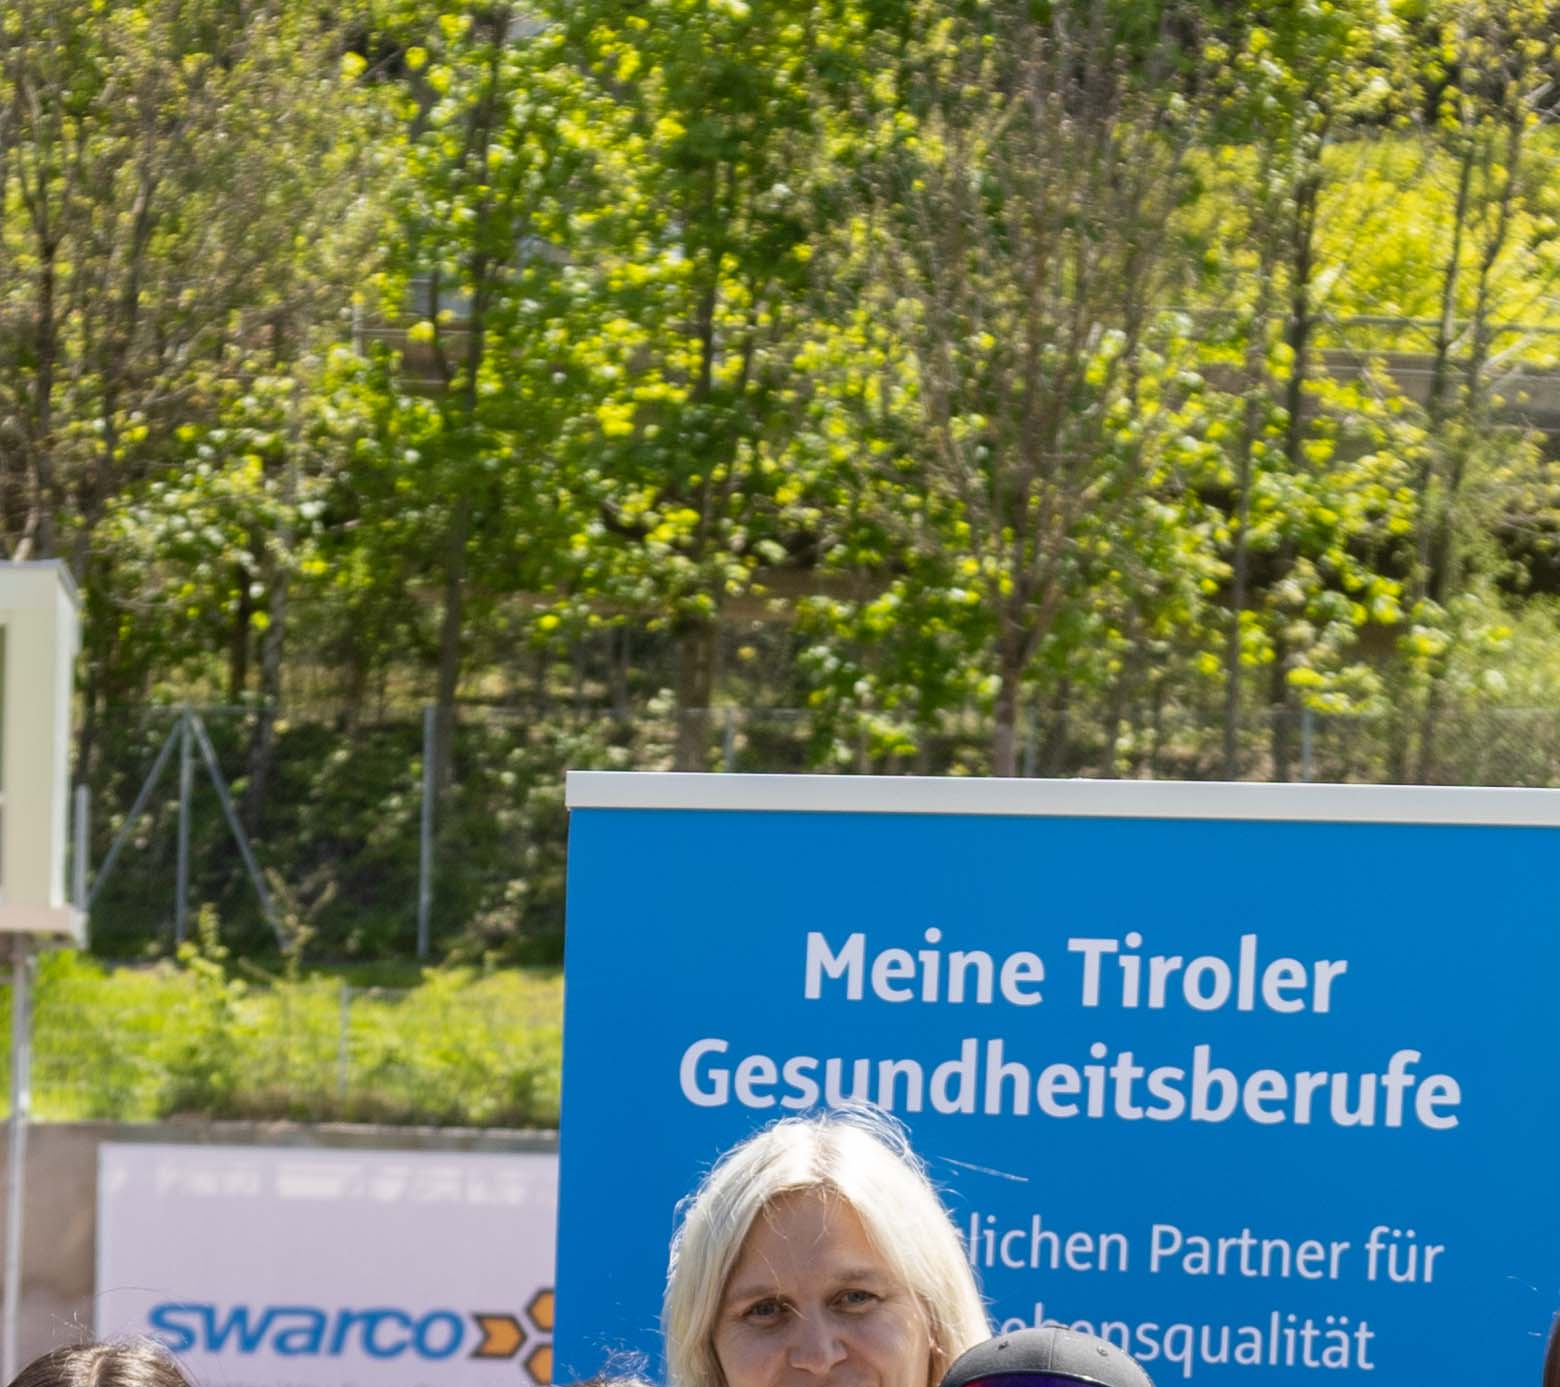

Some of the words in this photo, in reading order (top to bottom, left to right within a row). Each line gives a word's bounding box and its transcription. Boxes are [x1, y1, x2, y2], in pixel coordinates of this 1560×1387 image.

[803, 927, 1046, 1006] Meine
[1068, 932, 1348, 1014] Tiroler
[679, 1037, 1464, 1131] Gesundheitsberufe
[967, 1211, 1129, 1274] lichen
[1149, 1223, 1351, 1280] Partner
[1364, 1225, 1445, 1284] für
[147, 1303, 465, 1361] swarco
